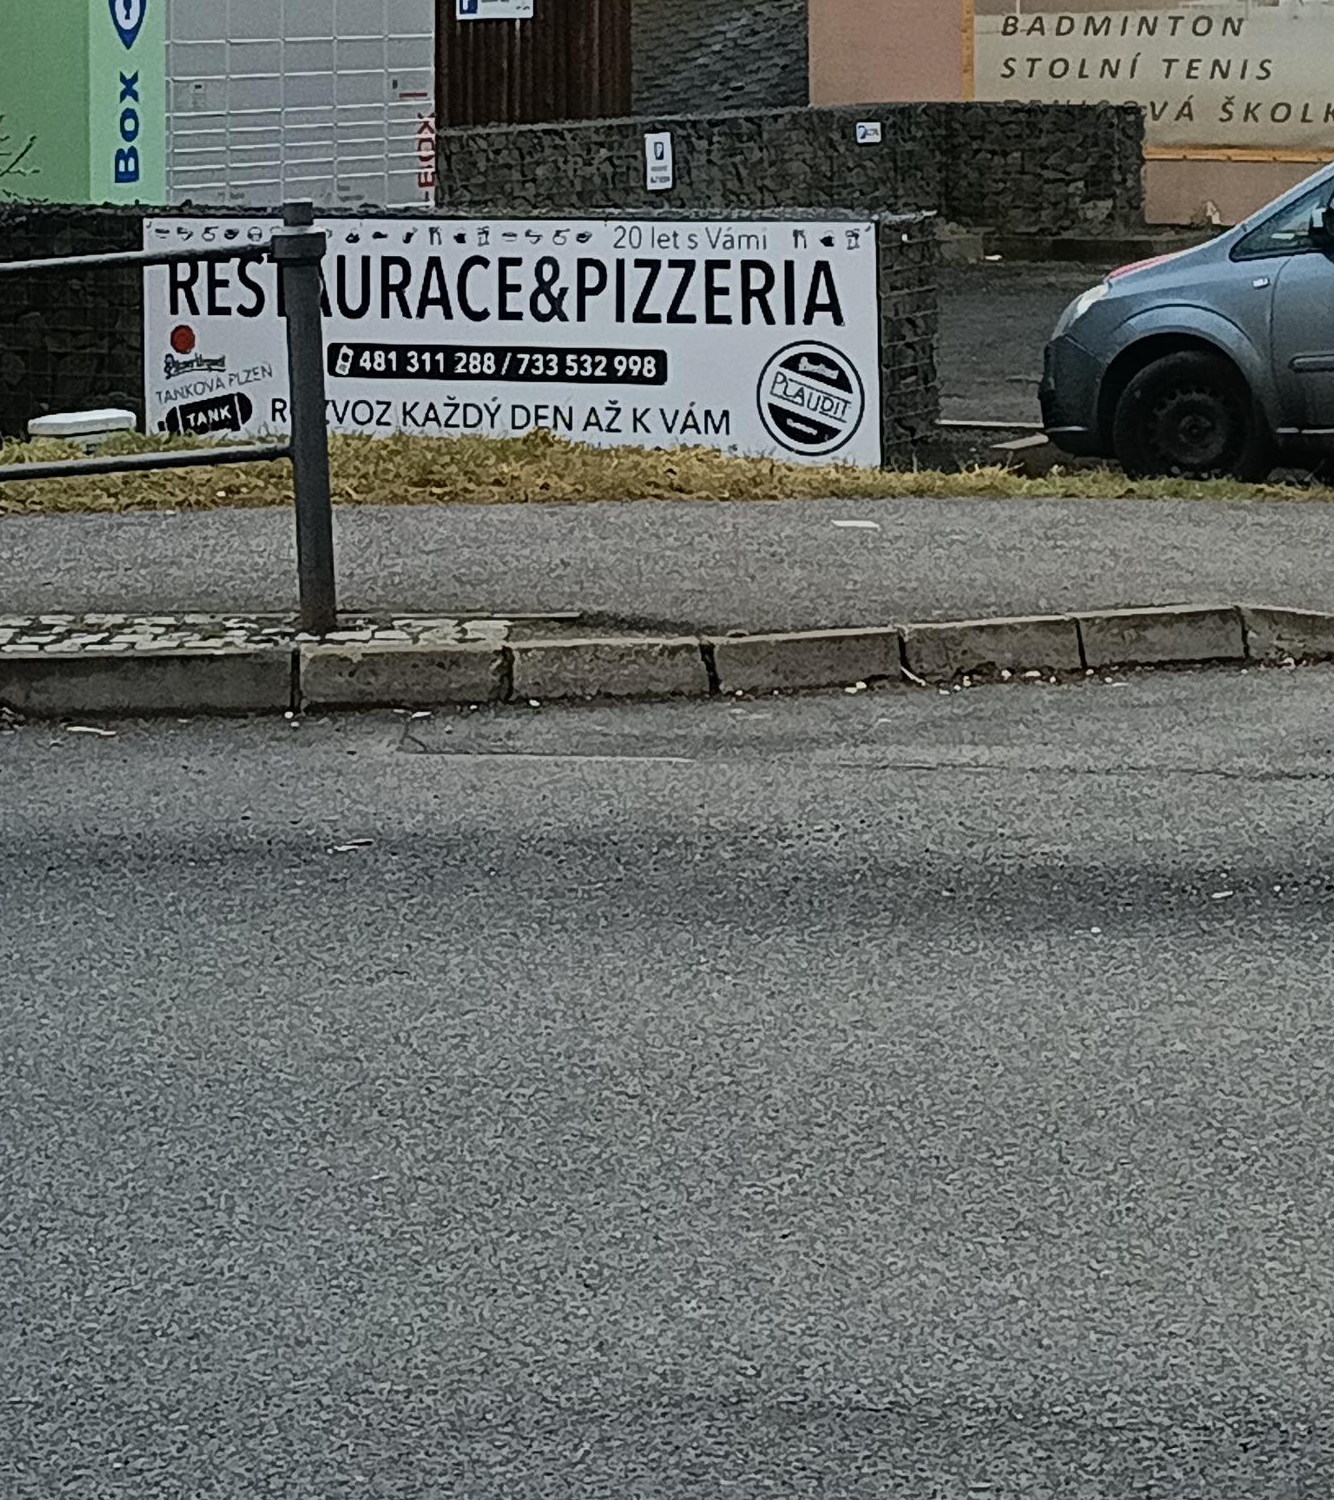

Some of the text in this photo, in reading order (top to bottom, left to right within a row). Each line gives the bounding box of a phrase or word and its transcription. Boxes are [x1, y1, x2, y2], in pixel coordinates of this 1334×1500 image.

[1001, 15, 1245, 37] BADMINTON
[1000, 52, 1273, 80] STOLNÍ TENIS
[114, 69, 139, 184] BOX
[613, 225, 768, 250] 20 let s Vámi
[359, 350, 397, 372] 481
[406, 351, 444, 373] 311
[517, 354, 558, 376] 733
[566, 355, 607, 376] 532
[614, 356, 656, 378] 998
[186, 404, 232, 428] TANK
[271, 395, 730, 436] RVOZ KAŽDÝ DEN AŽ K VÁM
